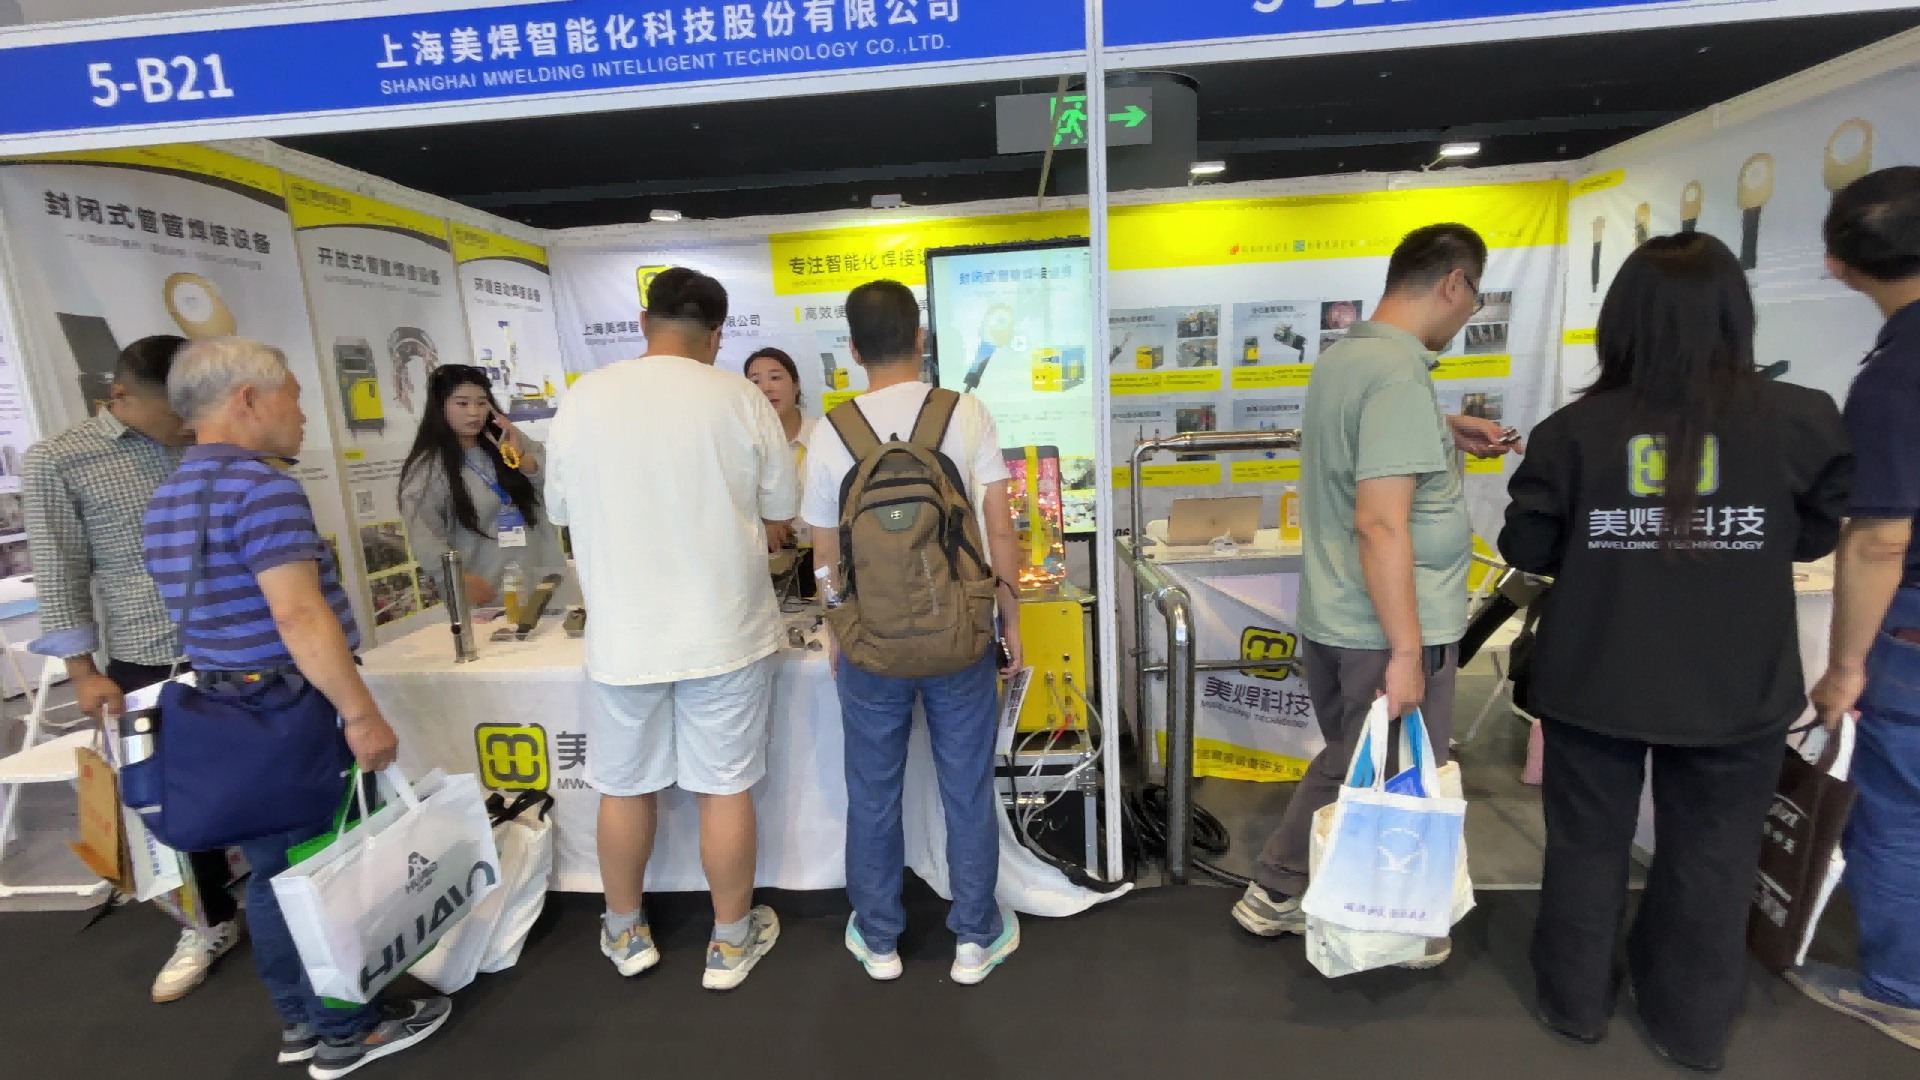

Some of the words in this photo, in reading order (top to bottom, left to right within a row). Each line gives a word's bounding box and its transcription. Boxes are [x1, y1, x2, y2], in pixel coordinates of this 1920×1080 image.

[376, 0, 959, 68] 上海美焊智能化科技股份有限公司
[89, 53, 234, 107] 5-B21
[380, 74, 477, 95] SHANGHAI
[483, 64, 586, 87] MWELDING
[592, 53, 717, 77] INTELLIGENT
[723, 41, 859, 67] TECHNOLOGY
[1204, 676, 1310, 717] 美焊科技
